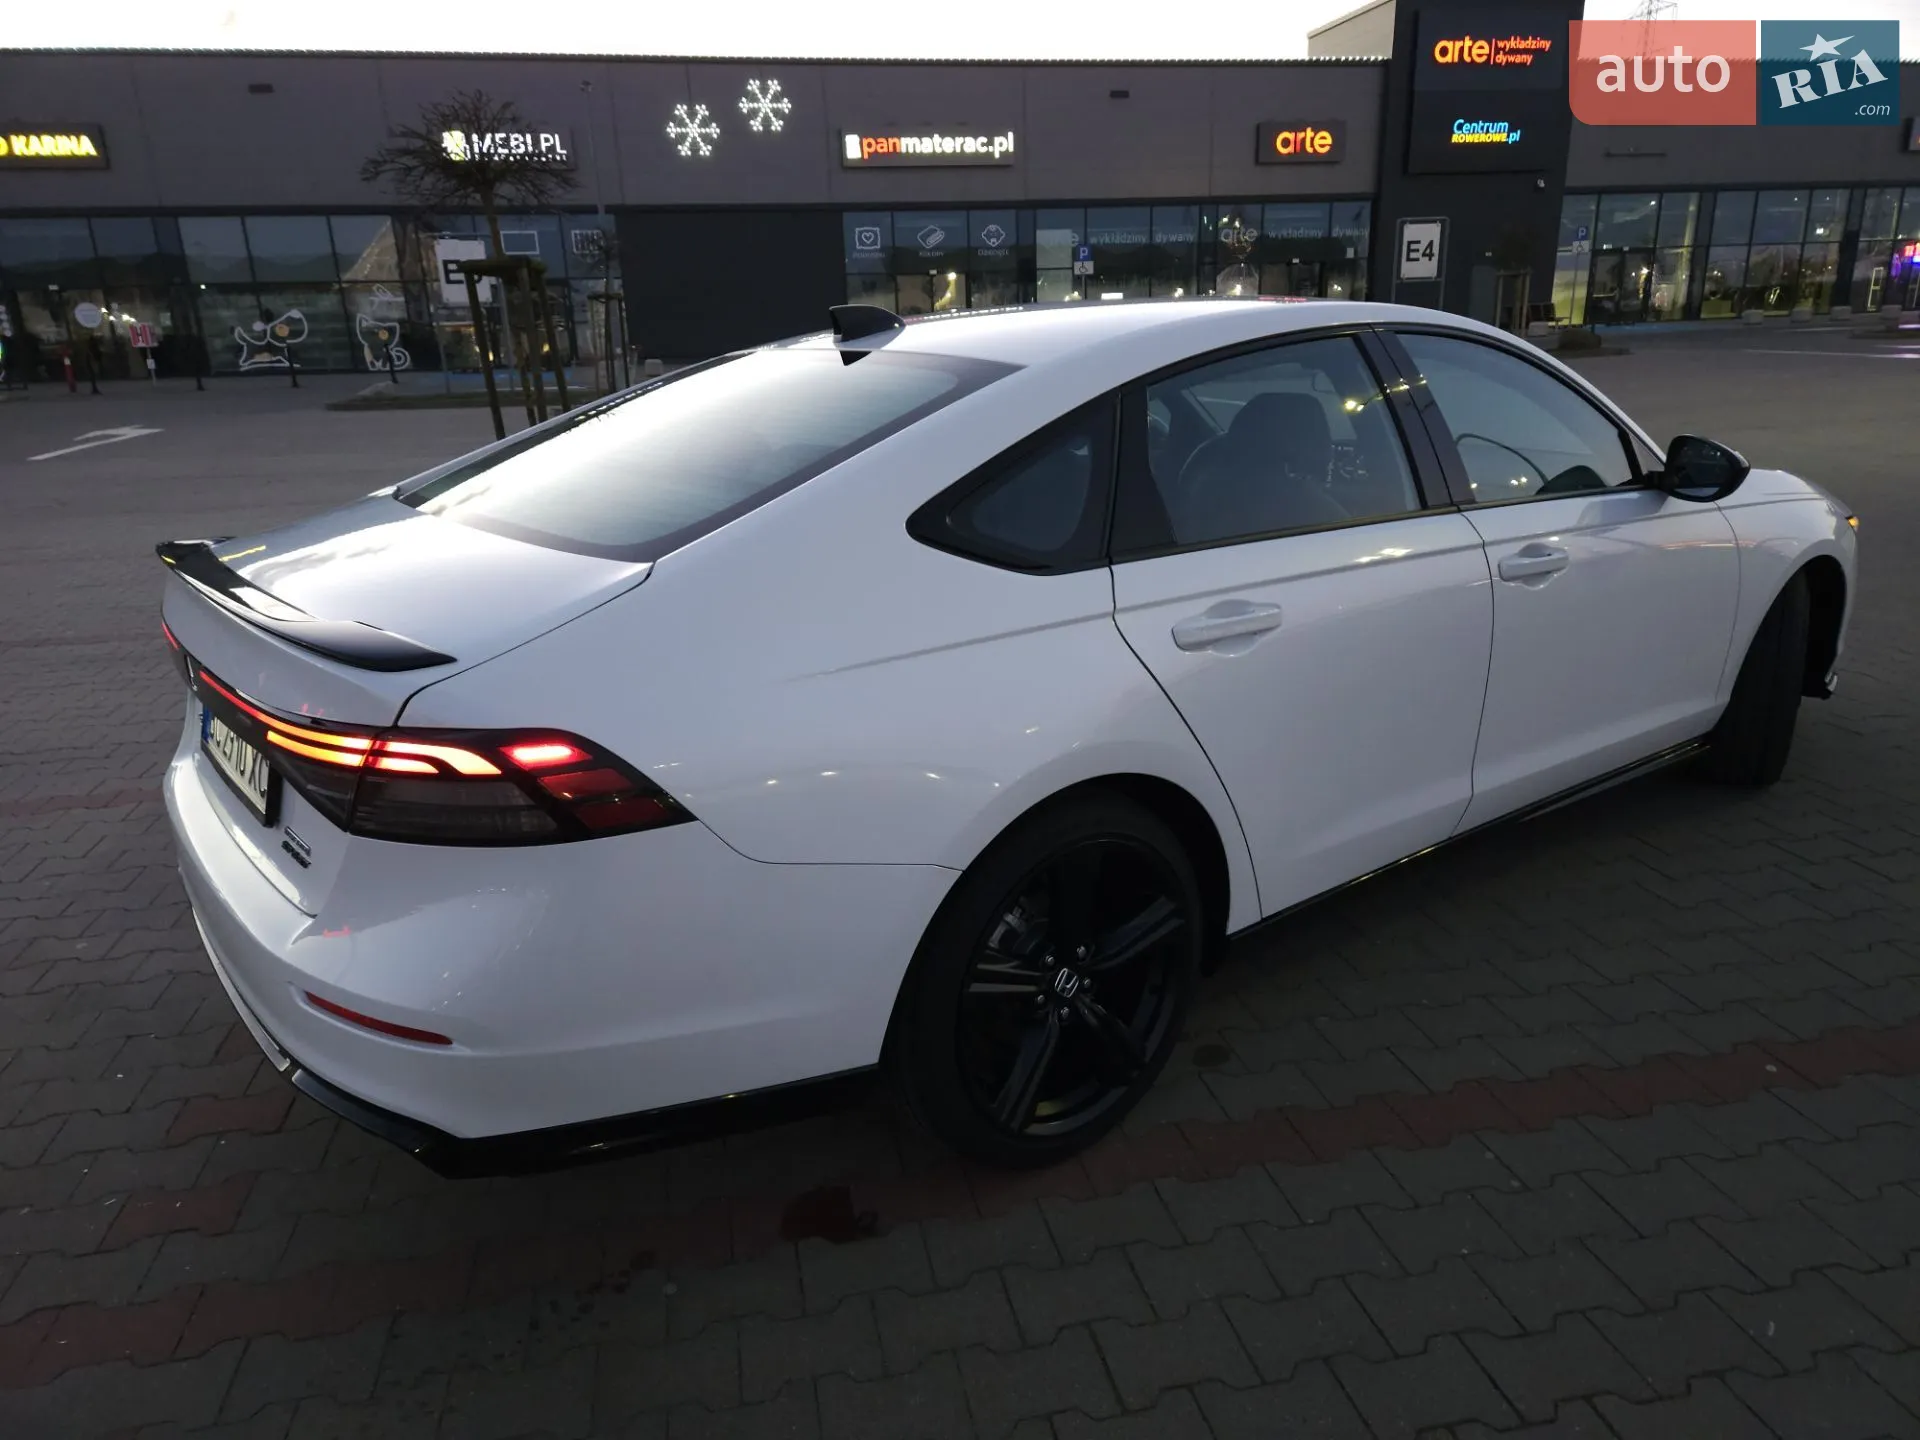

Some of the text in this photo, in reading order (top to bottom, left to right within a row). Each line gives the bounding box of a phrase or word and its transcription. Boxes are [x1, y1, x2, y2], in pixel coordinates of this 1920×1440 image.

[1434, 35, 1490, 64] arte
[1497, 36, 1552, 52] wykładziny
[1495, 50, 1534, 66] dywany
[1453, 119, 1509, 134] Centrum
[9, 134, 98, 157] KARINA
[862, 131, 1015, 159] panmaterac.pl
[1275, 126, 1333, 155] arte
[1220, 226, 1258, 243] arte
[1406, 238, 1435, 263] E4
